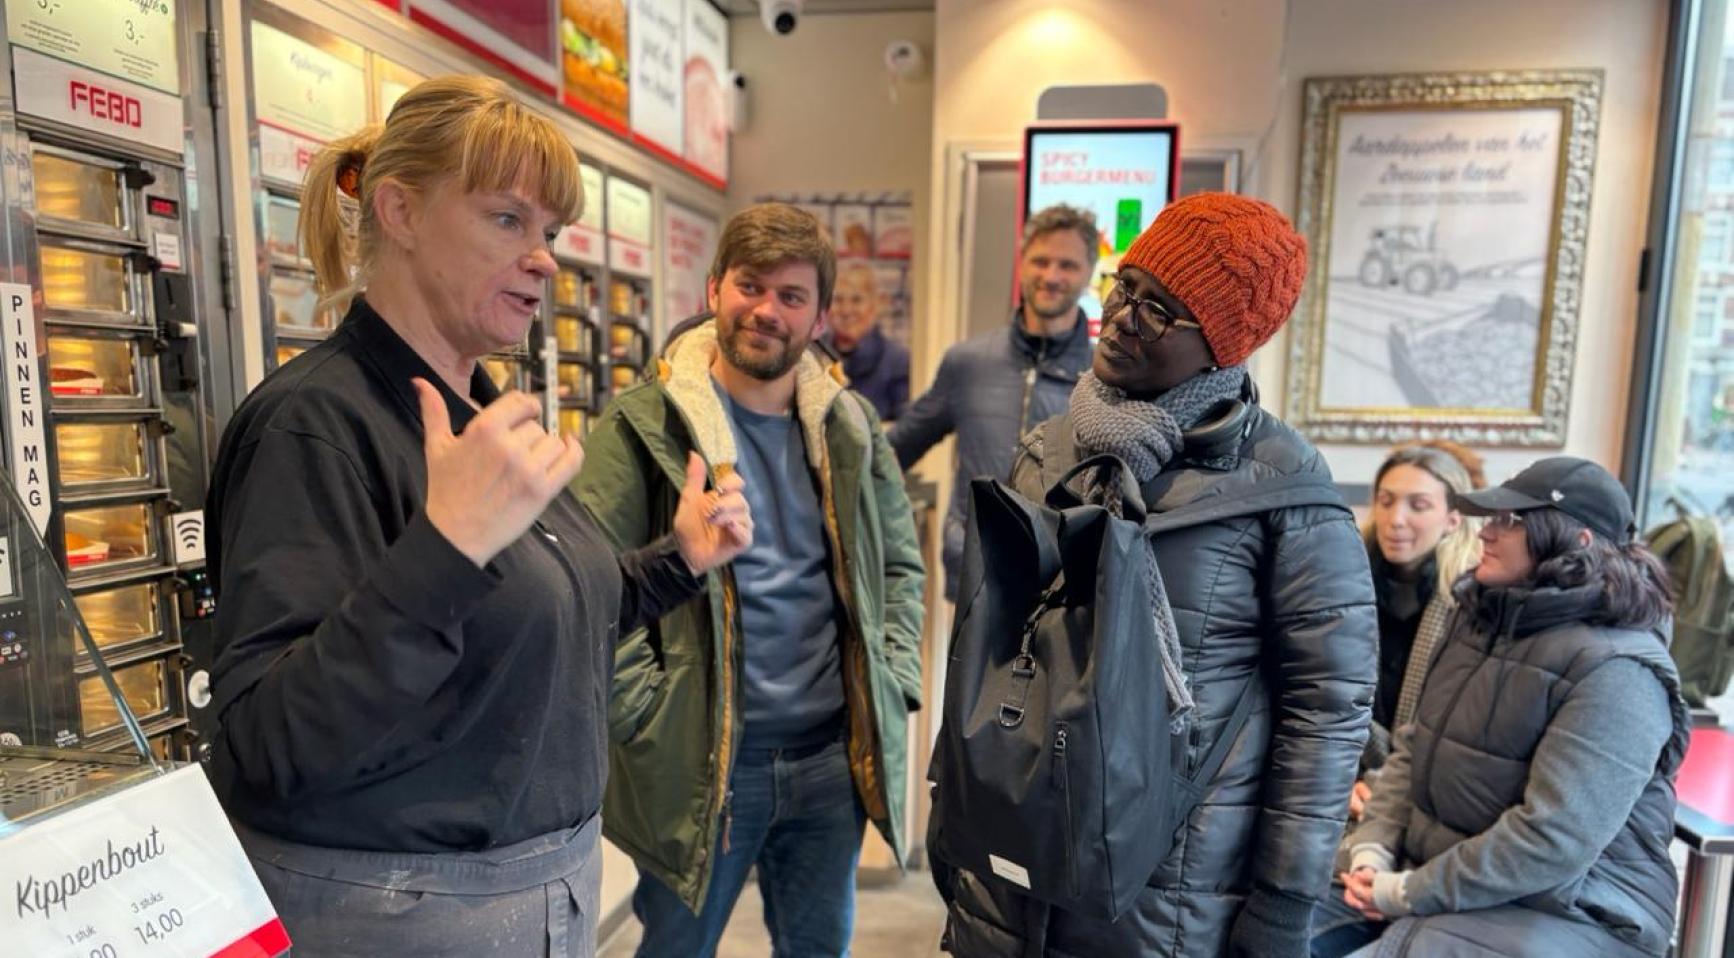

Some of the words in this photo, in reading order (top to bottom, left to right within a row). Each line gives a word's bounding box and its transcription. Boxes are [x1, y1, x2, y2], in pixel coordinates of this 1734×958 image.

[125, 19, 144, 45] 3,-
[69, 80, 142, 128] FEBO
[1041, 153, 1089, 167] SPICY
[1040, 170, 1155, 185] BURGERMENU
[11, 294, 34, 427] PINNEN
[24, 446, 41, 507] MAG
[17, 825, 165, 919] Kippenbout
[131, 902, 140, 914] 3
[140, 892, 163, 909] stuks
[66, 934, 74, 945] 1
[75, 925, 97, 942] stuk
[134, 908, 183, 944] 14,00
